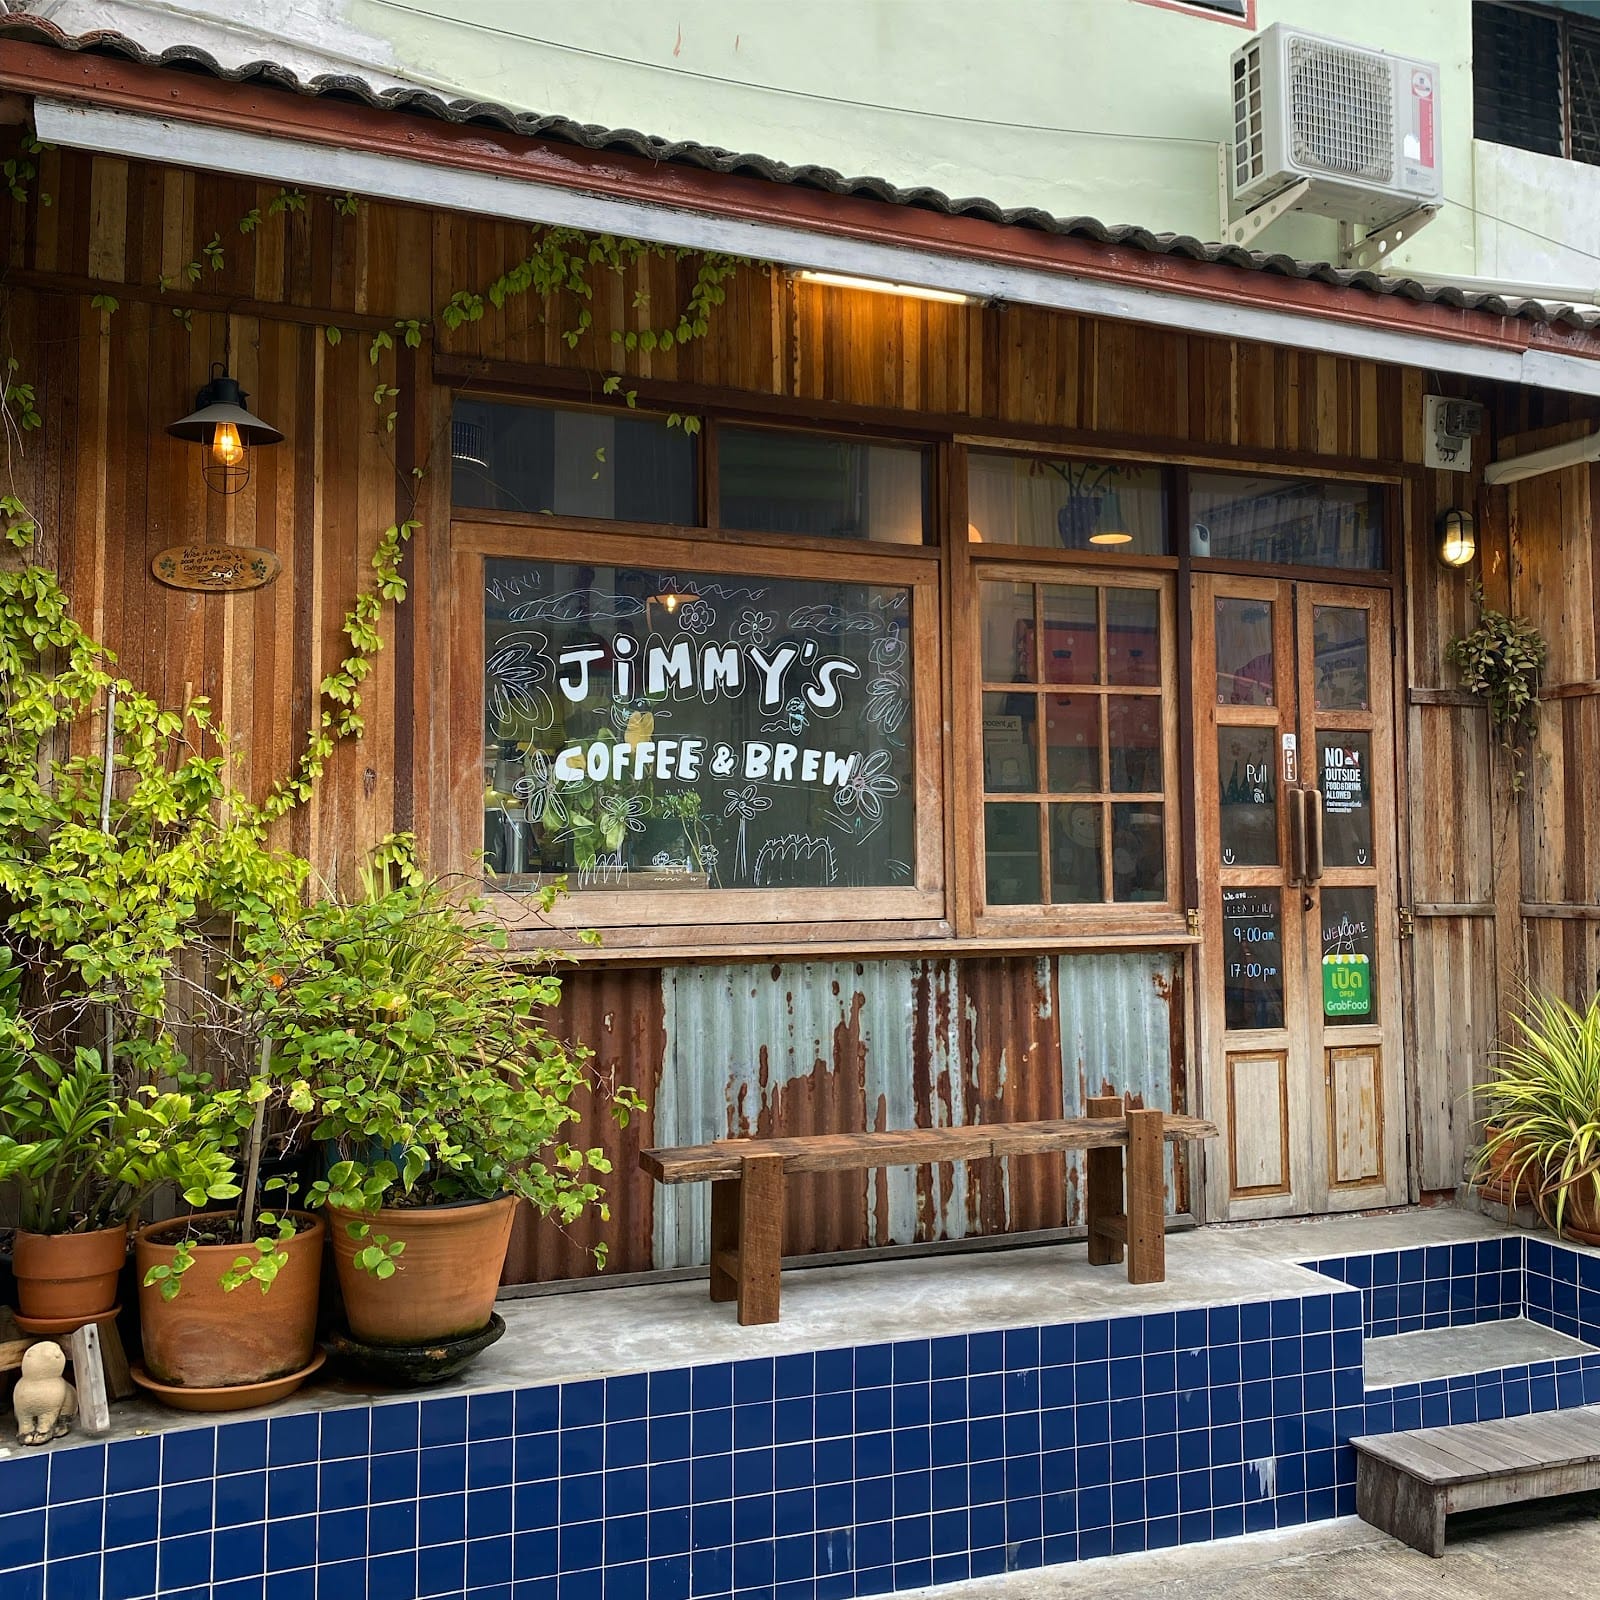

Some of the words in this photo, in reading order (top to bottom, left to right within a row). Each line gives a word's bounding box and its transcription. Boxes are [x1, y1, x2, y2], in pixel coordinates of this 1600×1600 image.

[554, 740, 702, 782] COFFEE
[711, 744, 735, 776] &
[745, 742, 856, 786] BREW
[1324, 747, 1344, 768] NO
[1246, 764, 1267, 783] Pull
[1325, 768, 1361, 782] OUTSIDE
[1326, 790, 1352, 800] ALLOWED
[1322, 922, 1367, 942] WELCOME
[1332, 967, 1362, 990] เปิด
[1326, 1000, 1368, 1011] GrabFood
